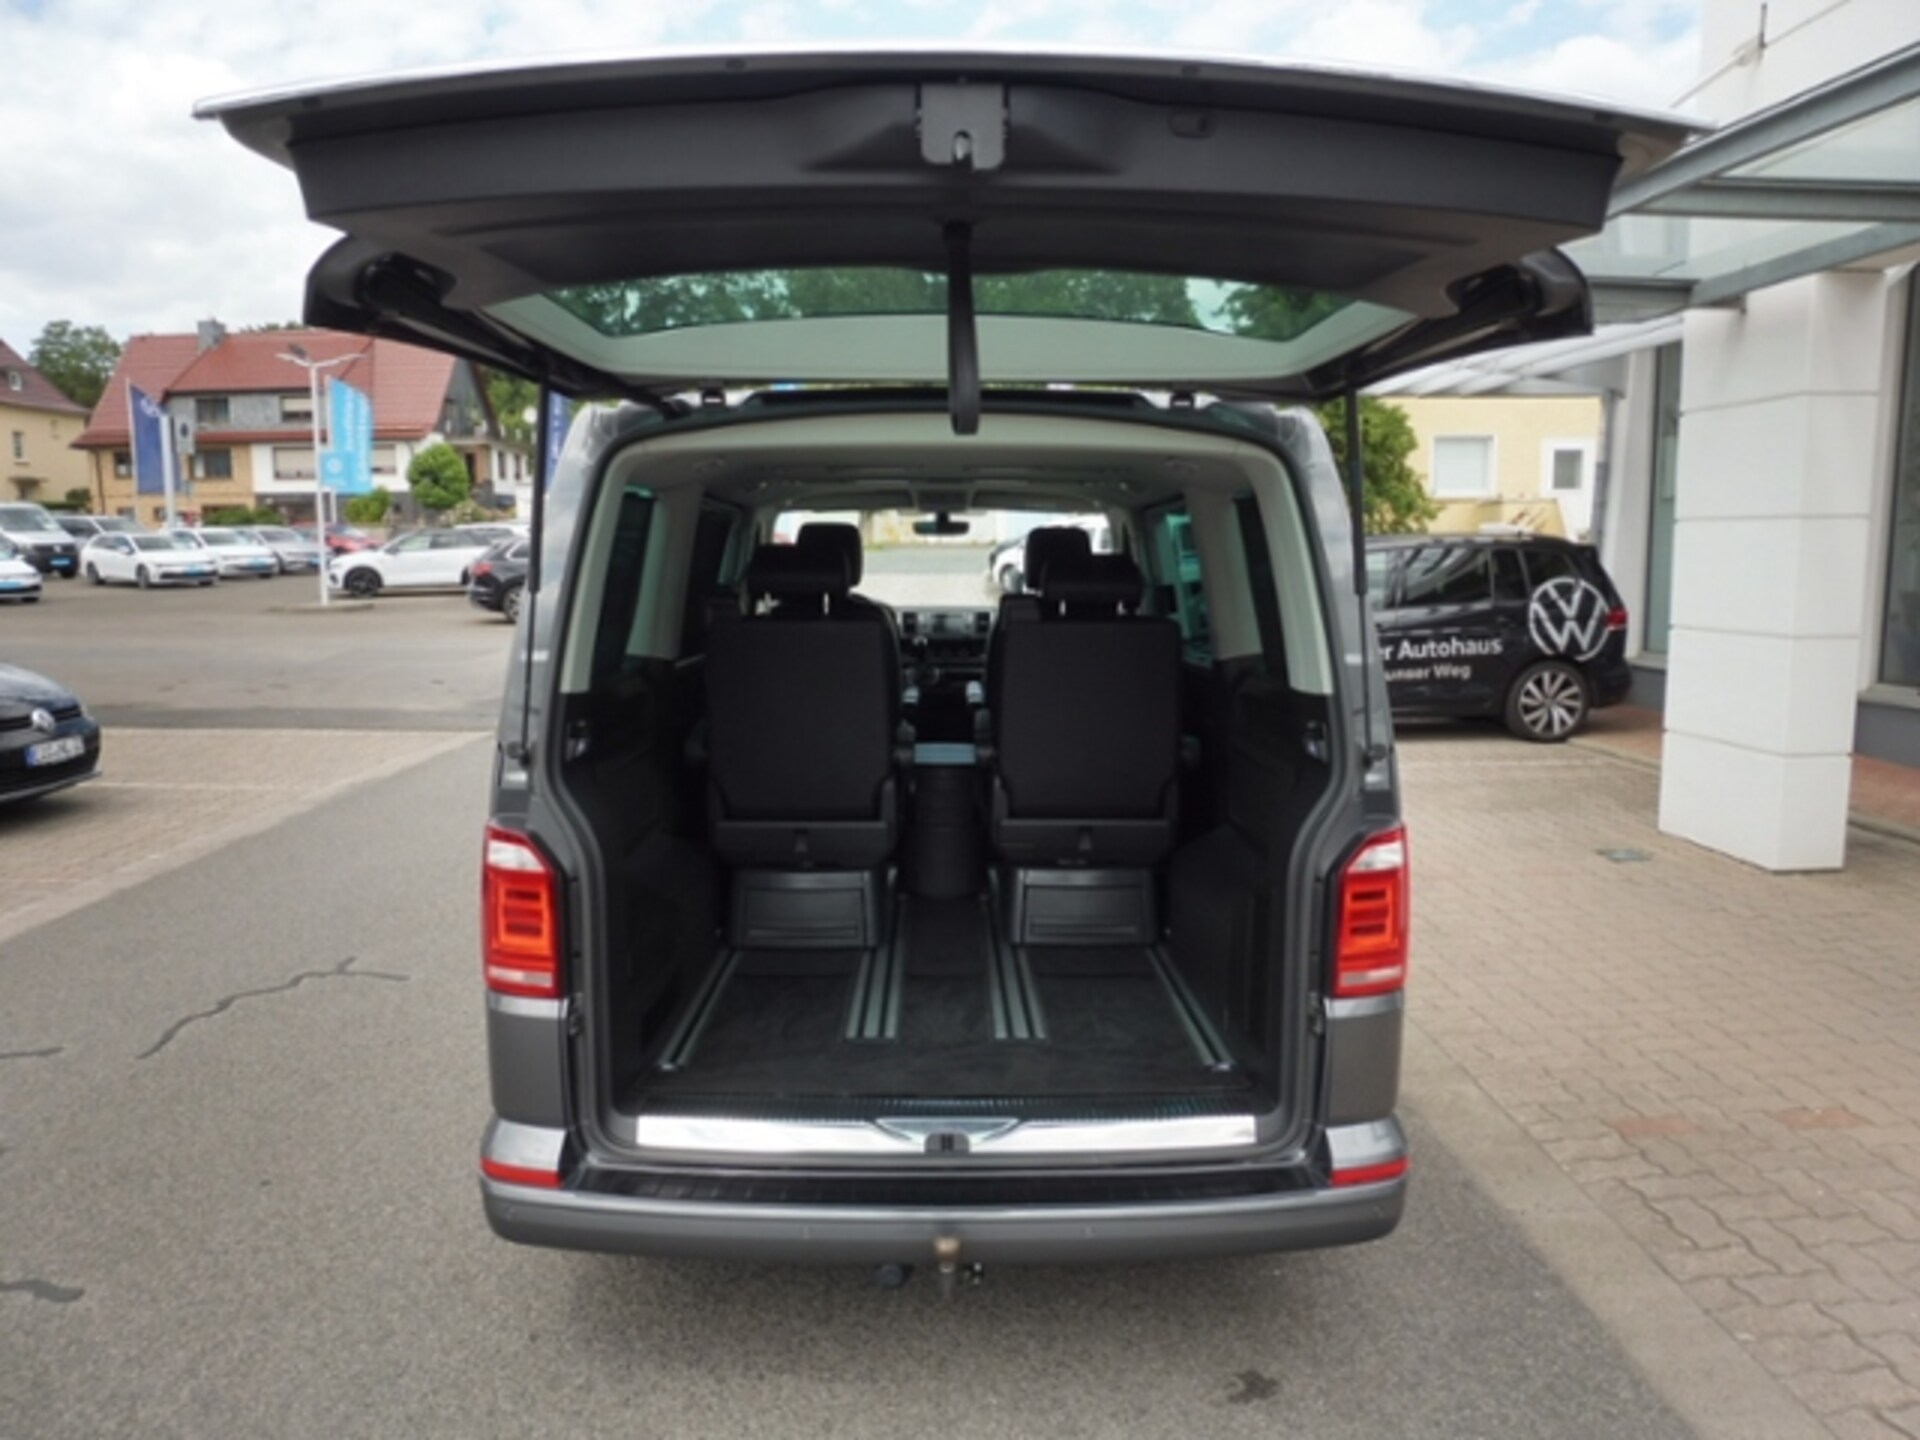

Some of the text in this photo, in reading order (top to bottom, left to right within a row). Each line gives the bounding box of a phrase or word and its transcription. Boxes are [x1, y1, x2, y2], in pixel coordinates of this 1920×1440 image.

[1529, 577, 1610, 662] VW
[1396, 636, 1504, 660] Autohaus
[1433, 662, 1471, 681] Weg
